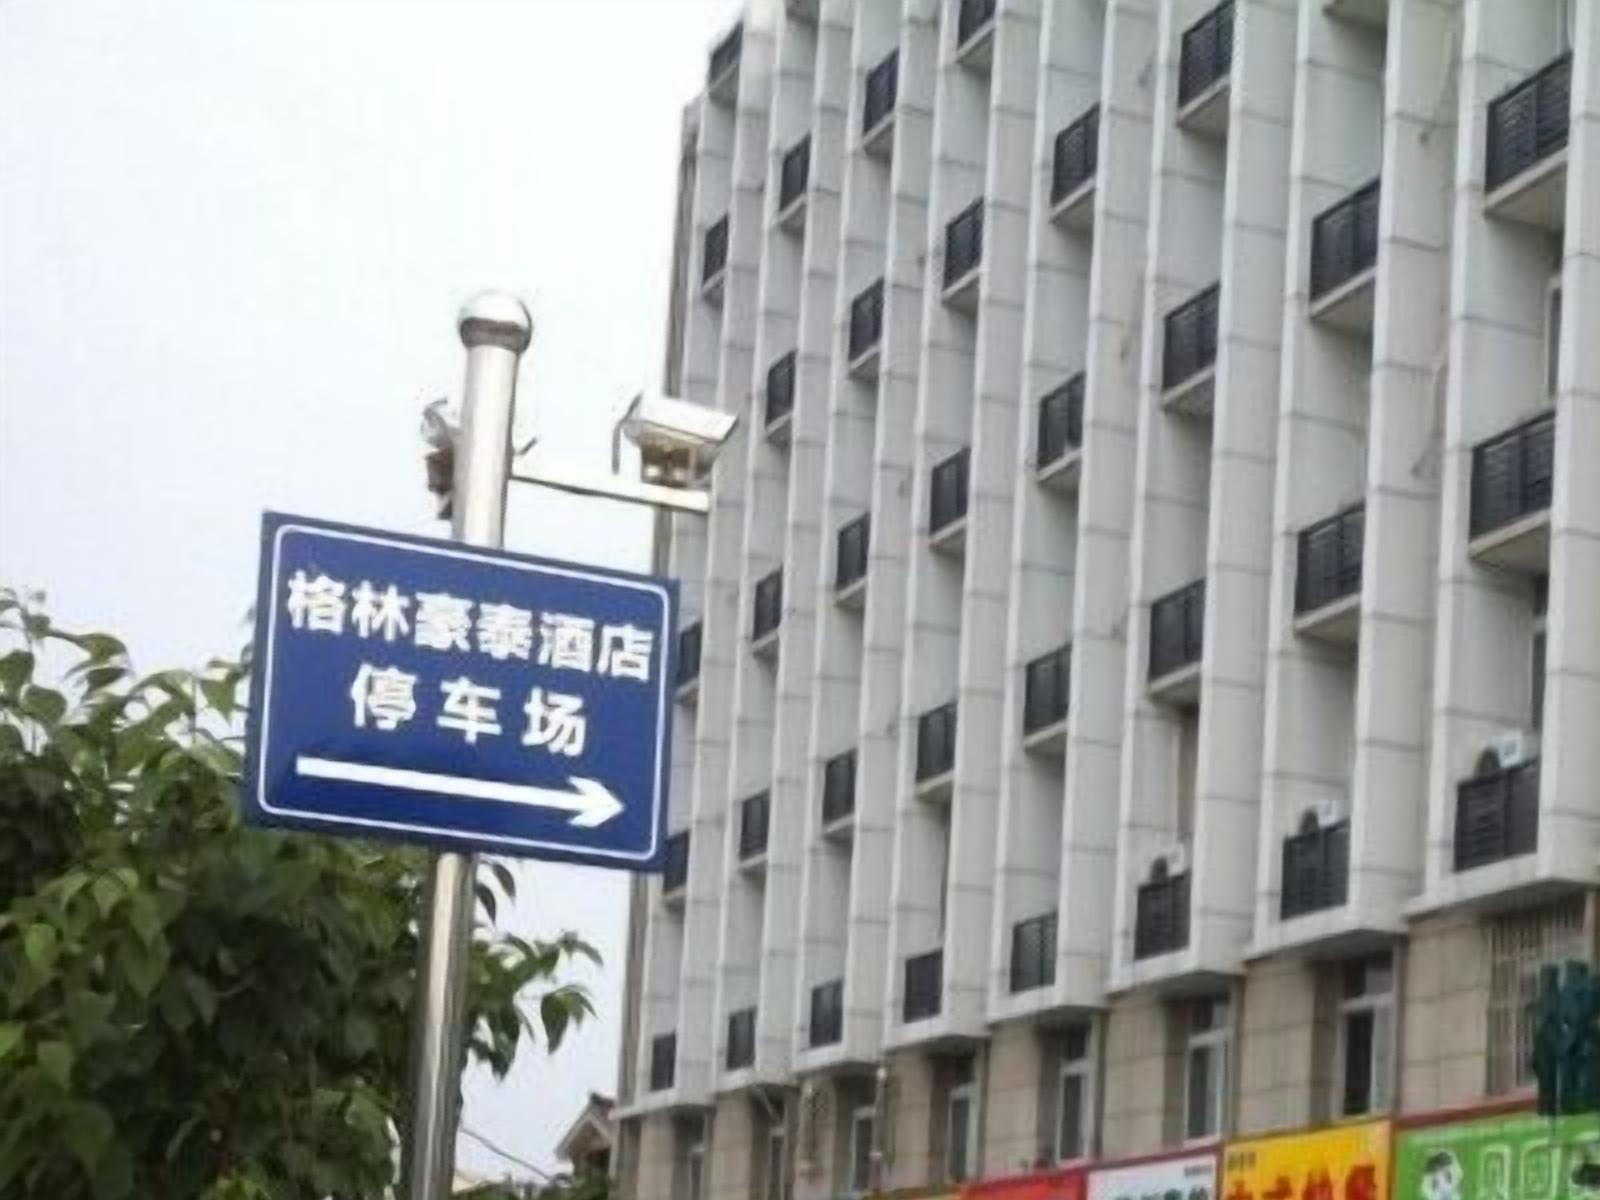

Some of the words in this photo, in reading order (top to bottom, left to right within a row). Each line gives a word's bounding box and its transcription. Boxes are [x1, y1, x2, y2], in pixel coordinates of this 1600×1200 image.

[287, 570, 654, 683] 格林豪泰酒店
[350, 663, 587, 757] 停车场
